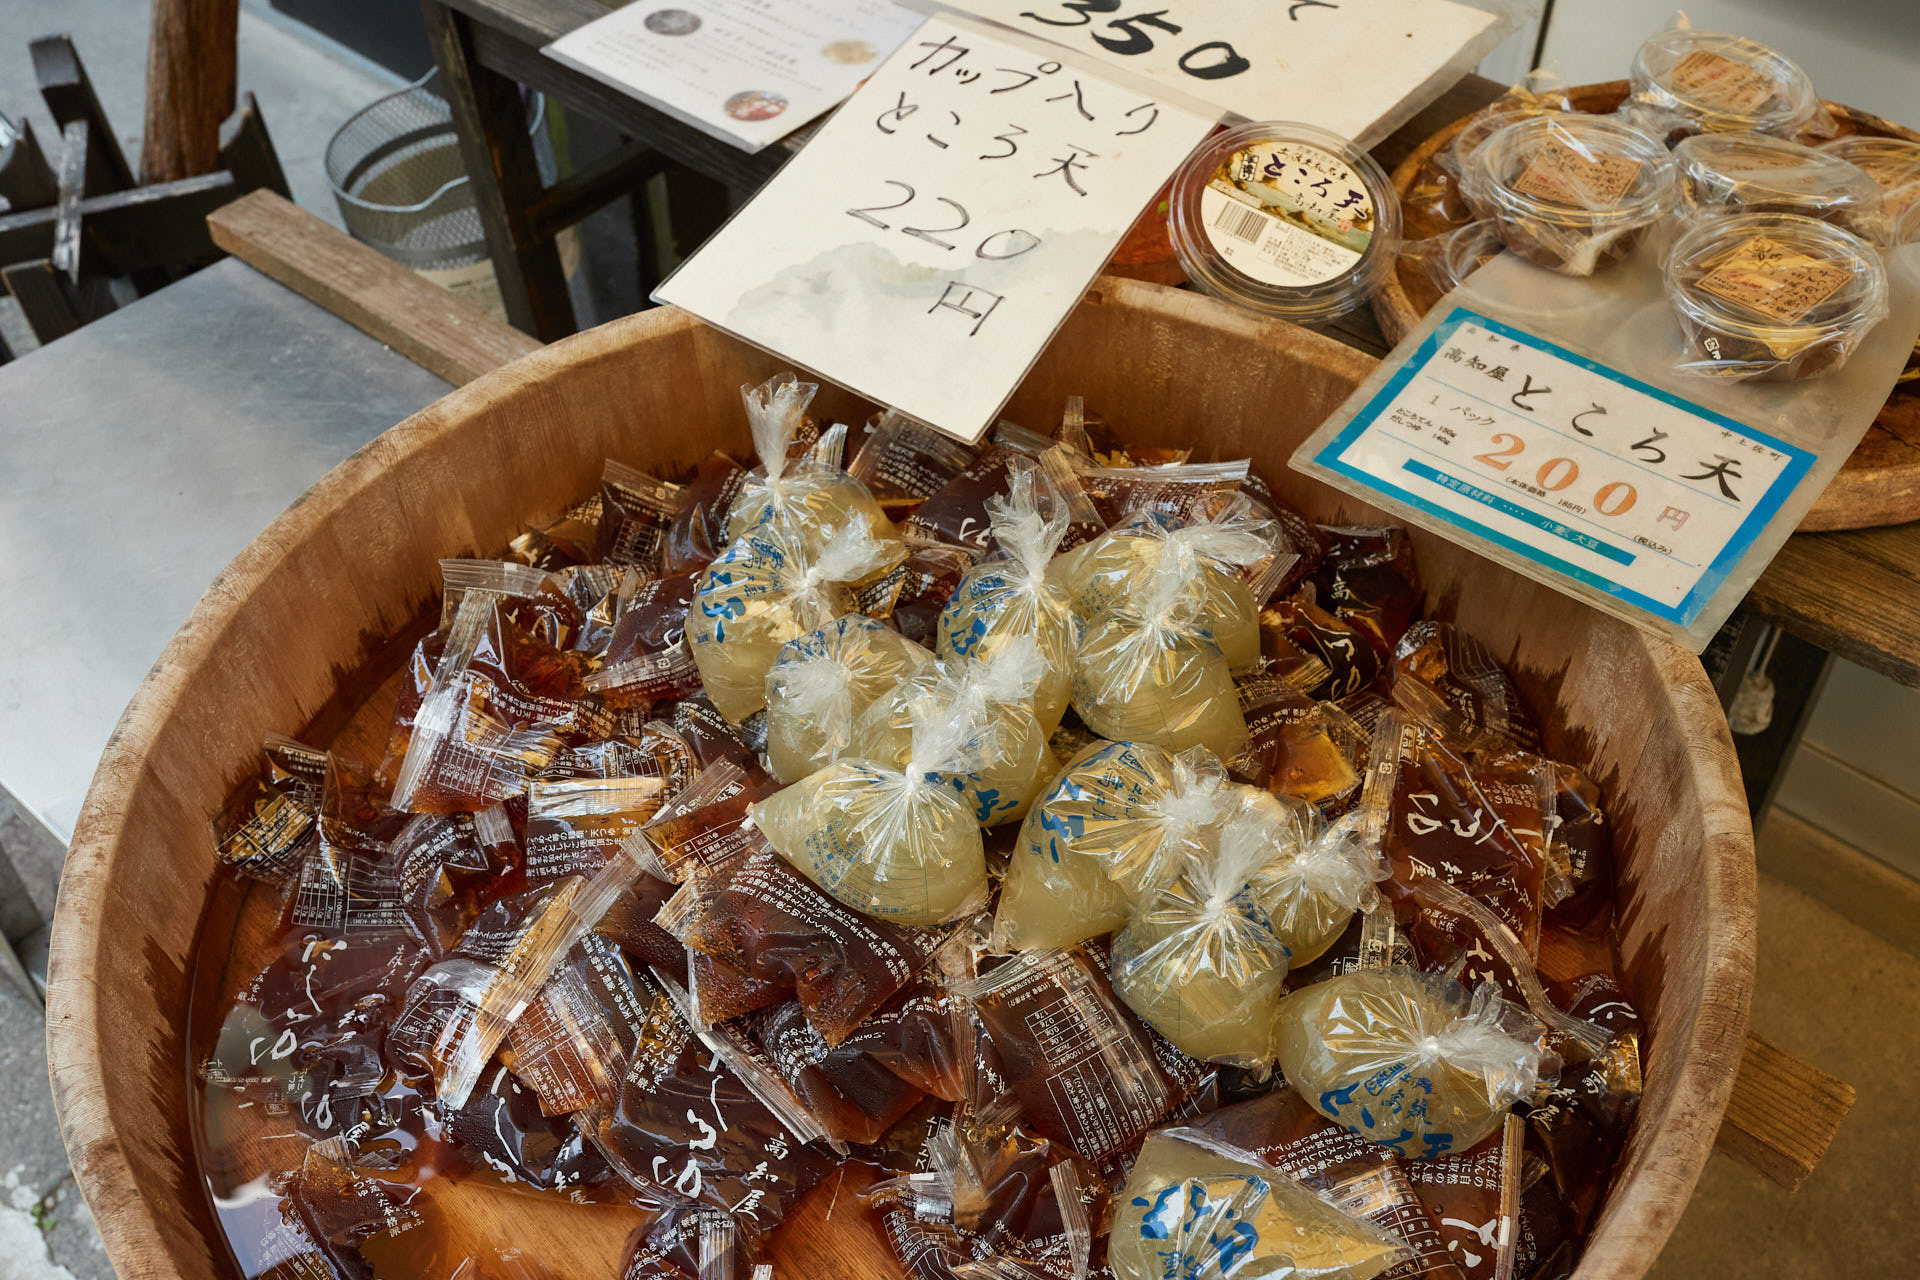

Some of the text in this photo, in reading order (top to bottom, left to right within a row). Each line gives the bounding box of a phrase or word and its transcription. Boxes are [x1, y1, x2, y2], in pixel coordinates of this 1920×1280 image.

[910, 36, 1159, 136] カップ入り
[876, 92, 1099, 196] ところ天
[846, 180, 1042, 260] 220
[928, 280, 1006, 336] 円
[1396, 408, 1433, 428] ところてん
[1444, 347, 1743, 502] 高知屋 ところ天
[1450, 406, 1496, 426] パック
[1720, 430, 1784, 461] 中土佐町
[1435, 473, 1496, 506] 特定原材料
[1473, 433, 1692, 532] 200 円
[730, 1132, 789, 1220] 高知屋
